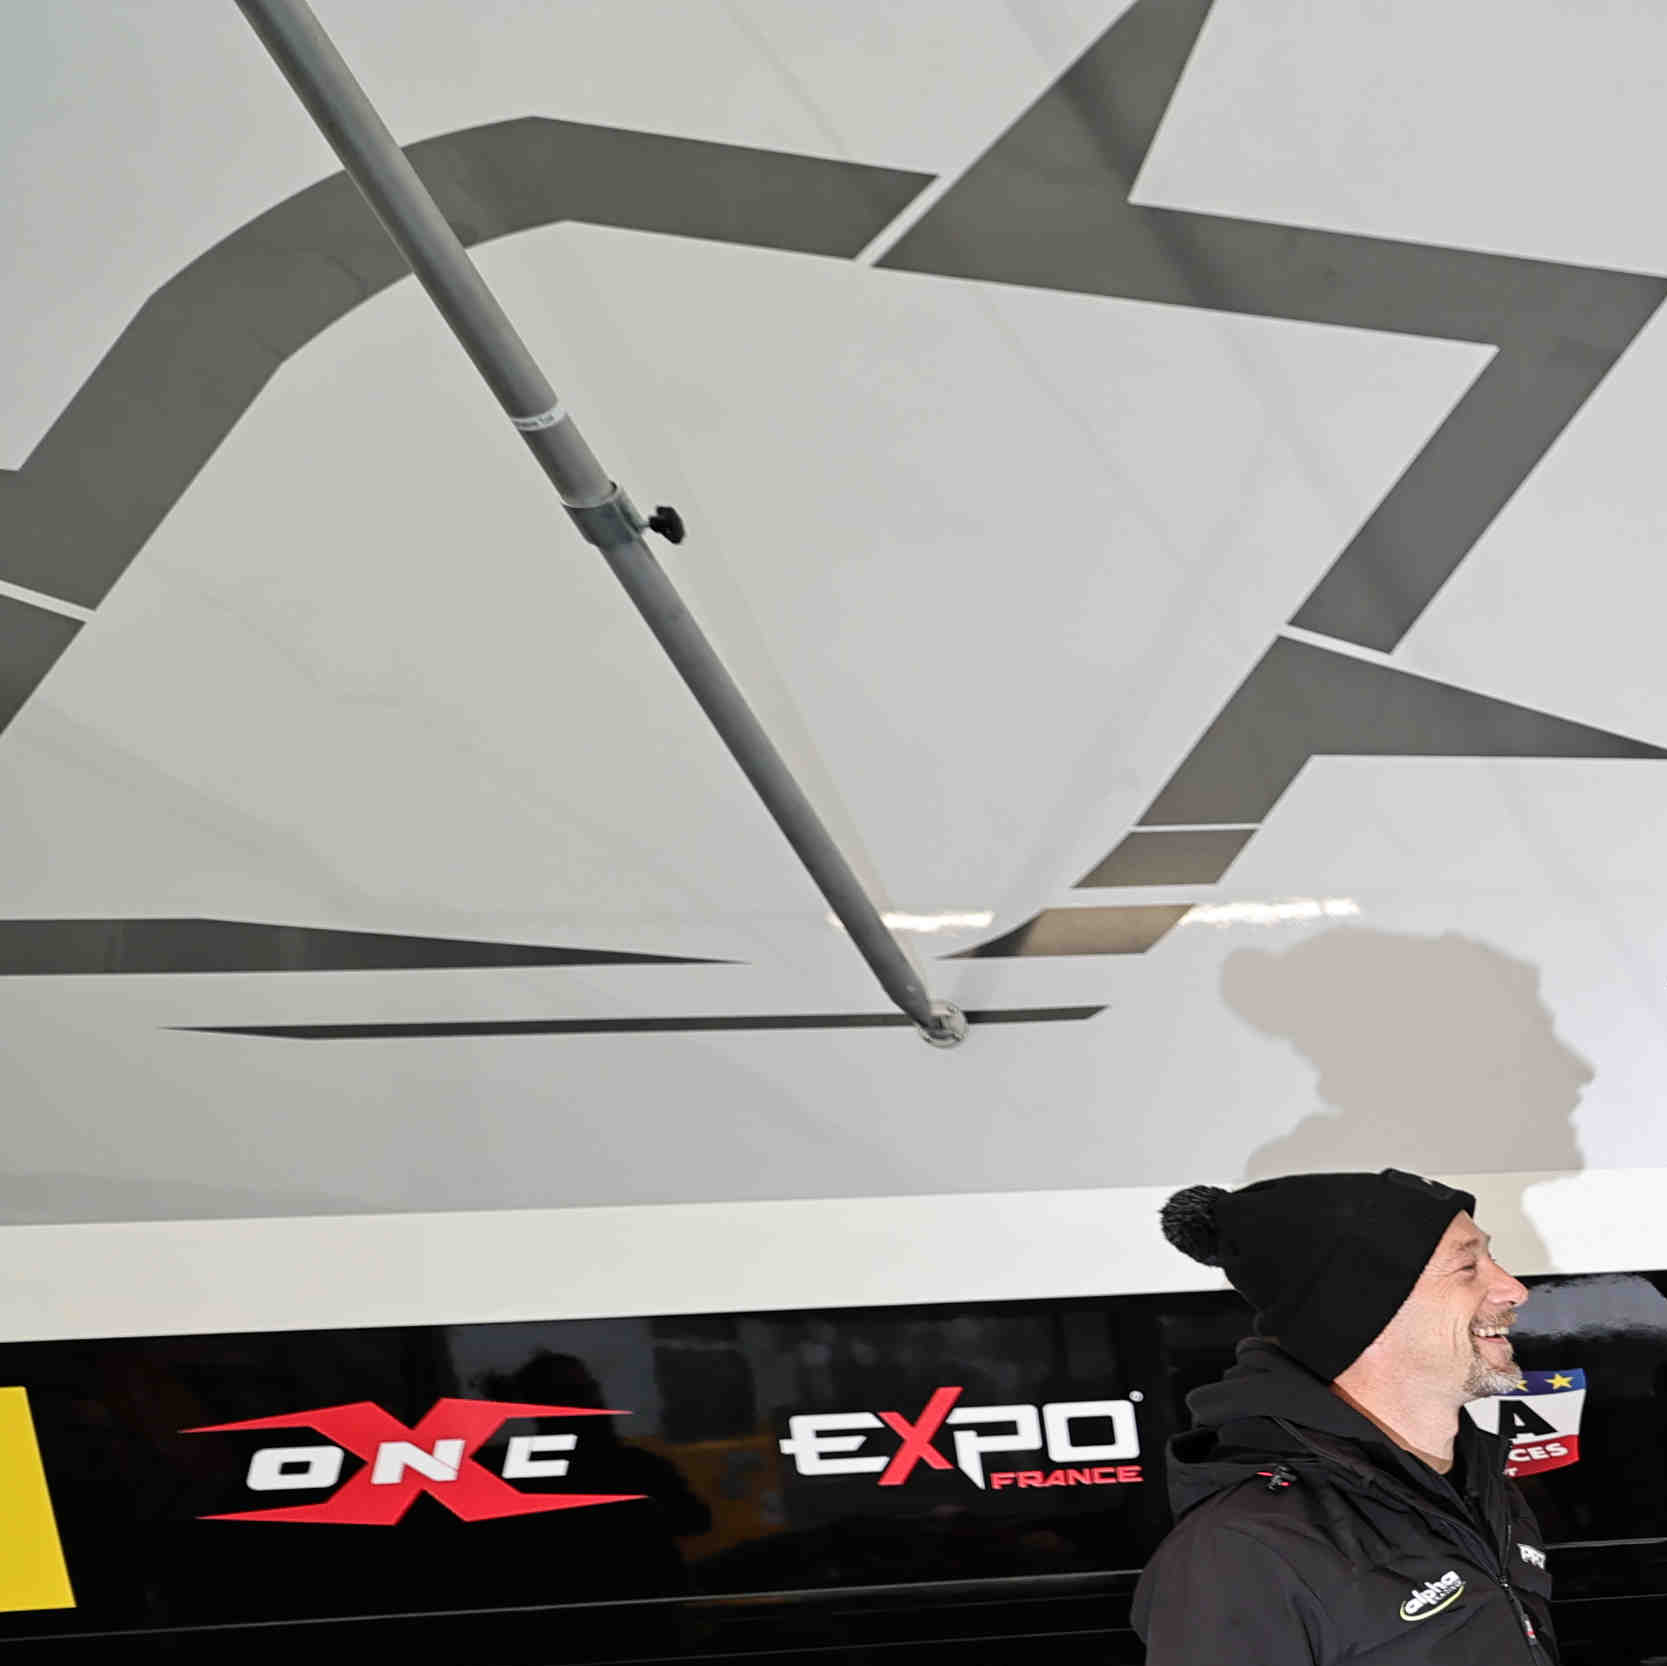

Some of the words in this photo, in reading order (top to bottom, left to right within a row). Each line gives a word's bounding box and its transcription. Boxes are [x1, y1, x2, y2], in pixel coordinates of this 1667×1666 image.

[779, 1386, 1141, 1490] EXPO
[246, 1434, 578, 1491] ONE
[990, 1465, 1144, 1489] FRANCE
[1405, 1571, 1461, 1609] alpha
